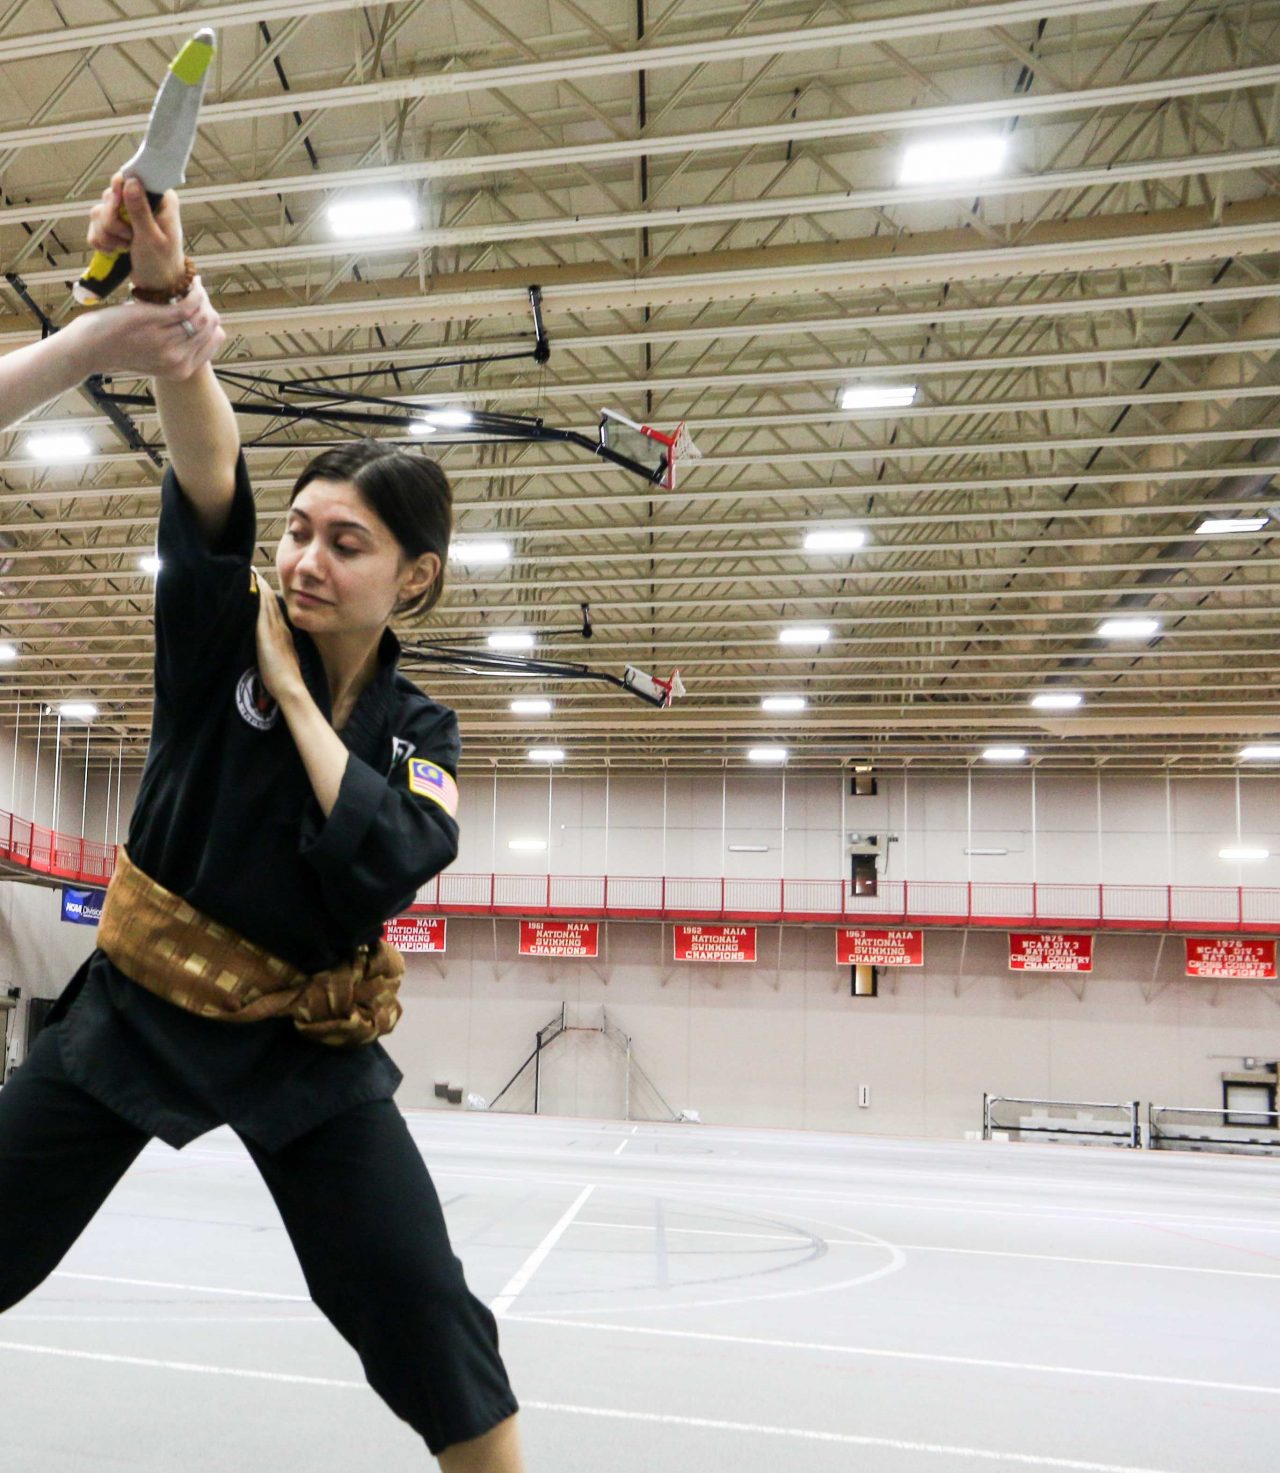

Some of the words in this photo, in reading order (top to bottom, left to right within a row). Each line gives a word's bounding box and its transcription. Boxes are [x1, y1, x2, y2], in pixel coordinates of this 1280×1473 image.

[416, 919, 438, 928] NAIA
[567, 923, 590, 931] NAIA
[387, 926, 431, 935] NATIONAL
[536, 930, 582, 939] NATIONAL
[683, 926, 702, 935] 1962
[723, 927, 747, 935] NAIA
[888, 931, 914, 939] NAIA
[386, 934, 431, 942] SWIMMING
[535, 938, 582, 947] SWIMMING
[691, 934, 739, 944] NATIONAL
[854, 938, 905, 947] NATIONAL
[691, 942, 739, 951] SWIMMING
[1022, 940, 1050, 949] NCAA
[529, 945, 587, 955] CHAMPIONS
[854, 946, 906, 956] SWIMMING
[1025, 948, 1076, 956] NATIONAL
[1196, 946, 1227, 955] NCAA
[685, 950, 745, 960] CHAMPIONS
[848, 954, 912, 964] CHAMPIONS
[1046, 955, 1090, 964] COUNTRY
[1202, 953, 1260, 962] NATIONAL
[1024, 962, 1078, 970] CHAMPIONS
[1225, 961, 1273, 970] COUNTRY
[1198, 968, 1265, 977] CHAMPIONS
